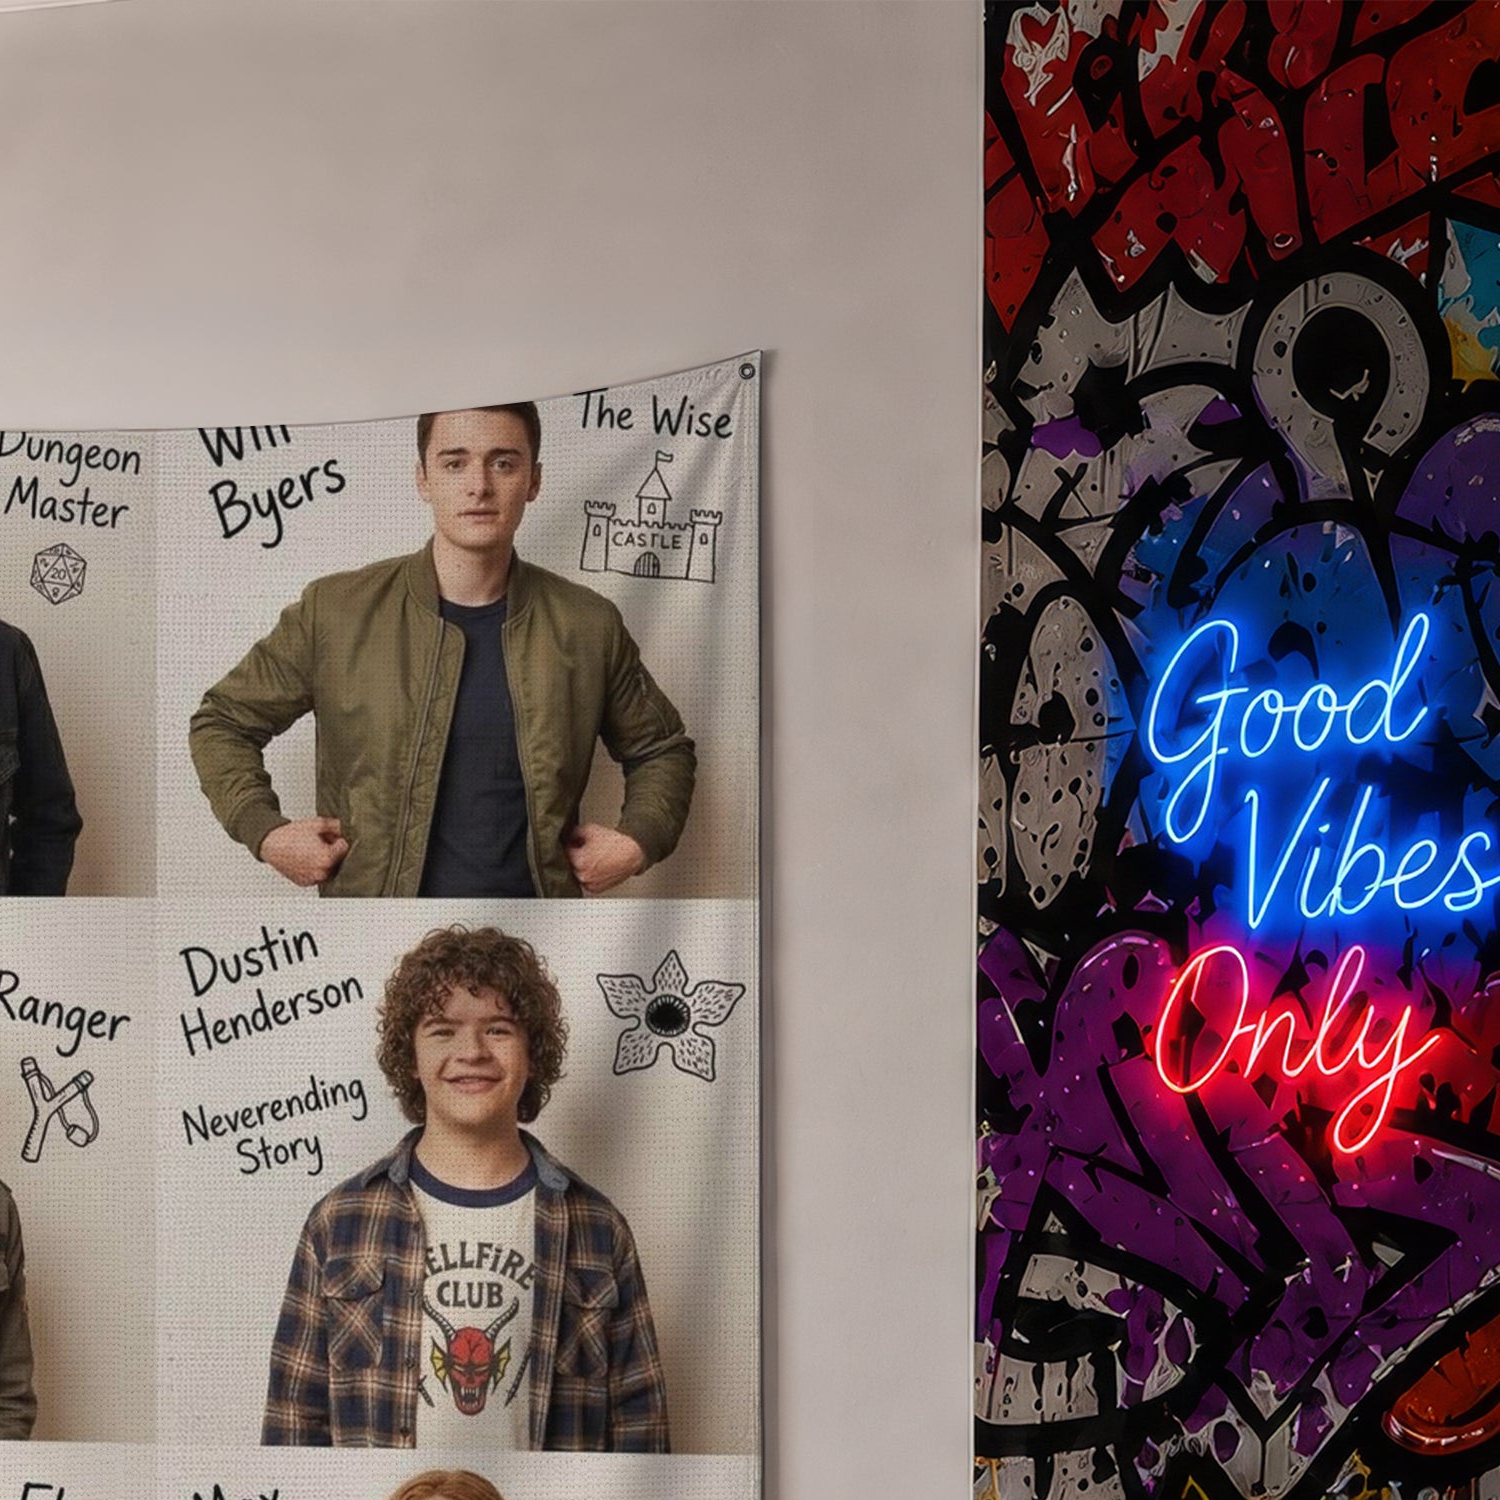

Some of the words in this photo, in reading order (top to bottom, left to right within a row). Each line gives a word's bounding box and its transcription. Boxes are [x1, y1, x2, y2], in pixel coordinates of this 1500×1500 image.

[572, 387, 634, 430] The
[652, 394, 733, 439] Wise
[4, 475, 129, 529] Master
[208, 459, 347, 549] Byers
[612, 532, 683, 550] CASTLE
[1147, 612, 1429, 844] Good
[1243, 777, 1500, 931] Vibes
[179, 925, 318, 997] Dustin
[180, 977, 364, 1056] Henderson
[1154, 944, 1441, 1154] Only
[182, 1075, 369, 1146] Neverending
[236, 1130, 324, 1176] Story
[437, 1280, 504, 1309] CLUB
